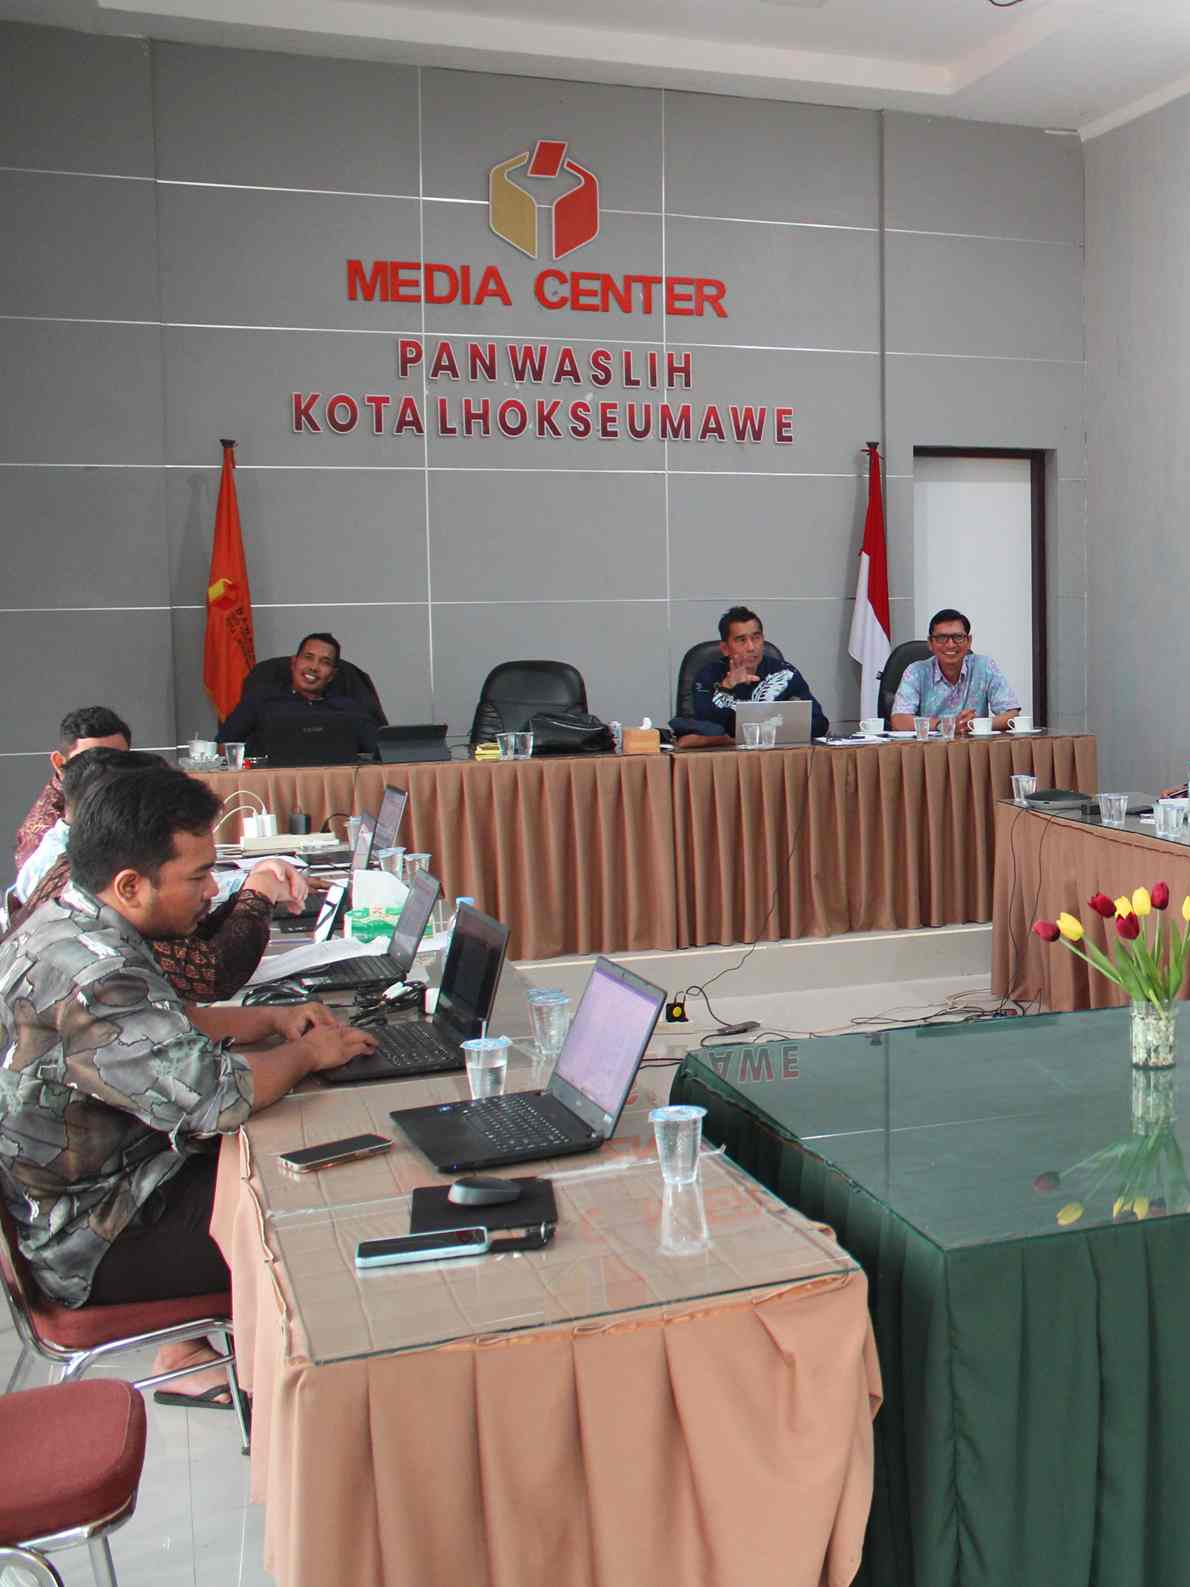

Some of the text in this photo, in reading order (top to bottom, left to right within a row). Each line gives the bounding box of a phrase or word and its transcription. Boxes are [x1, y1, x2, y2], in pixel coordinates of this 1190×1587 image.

[346, 259, 729, 318] MEDIA CENTER
[398, 338, 693, 389] PANWASLIH
